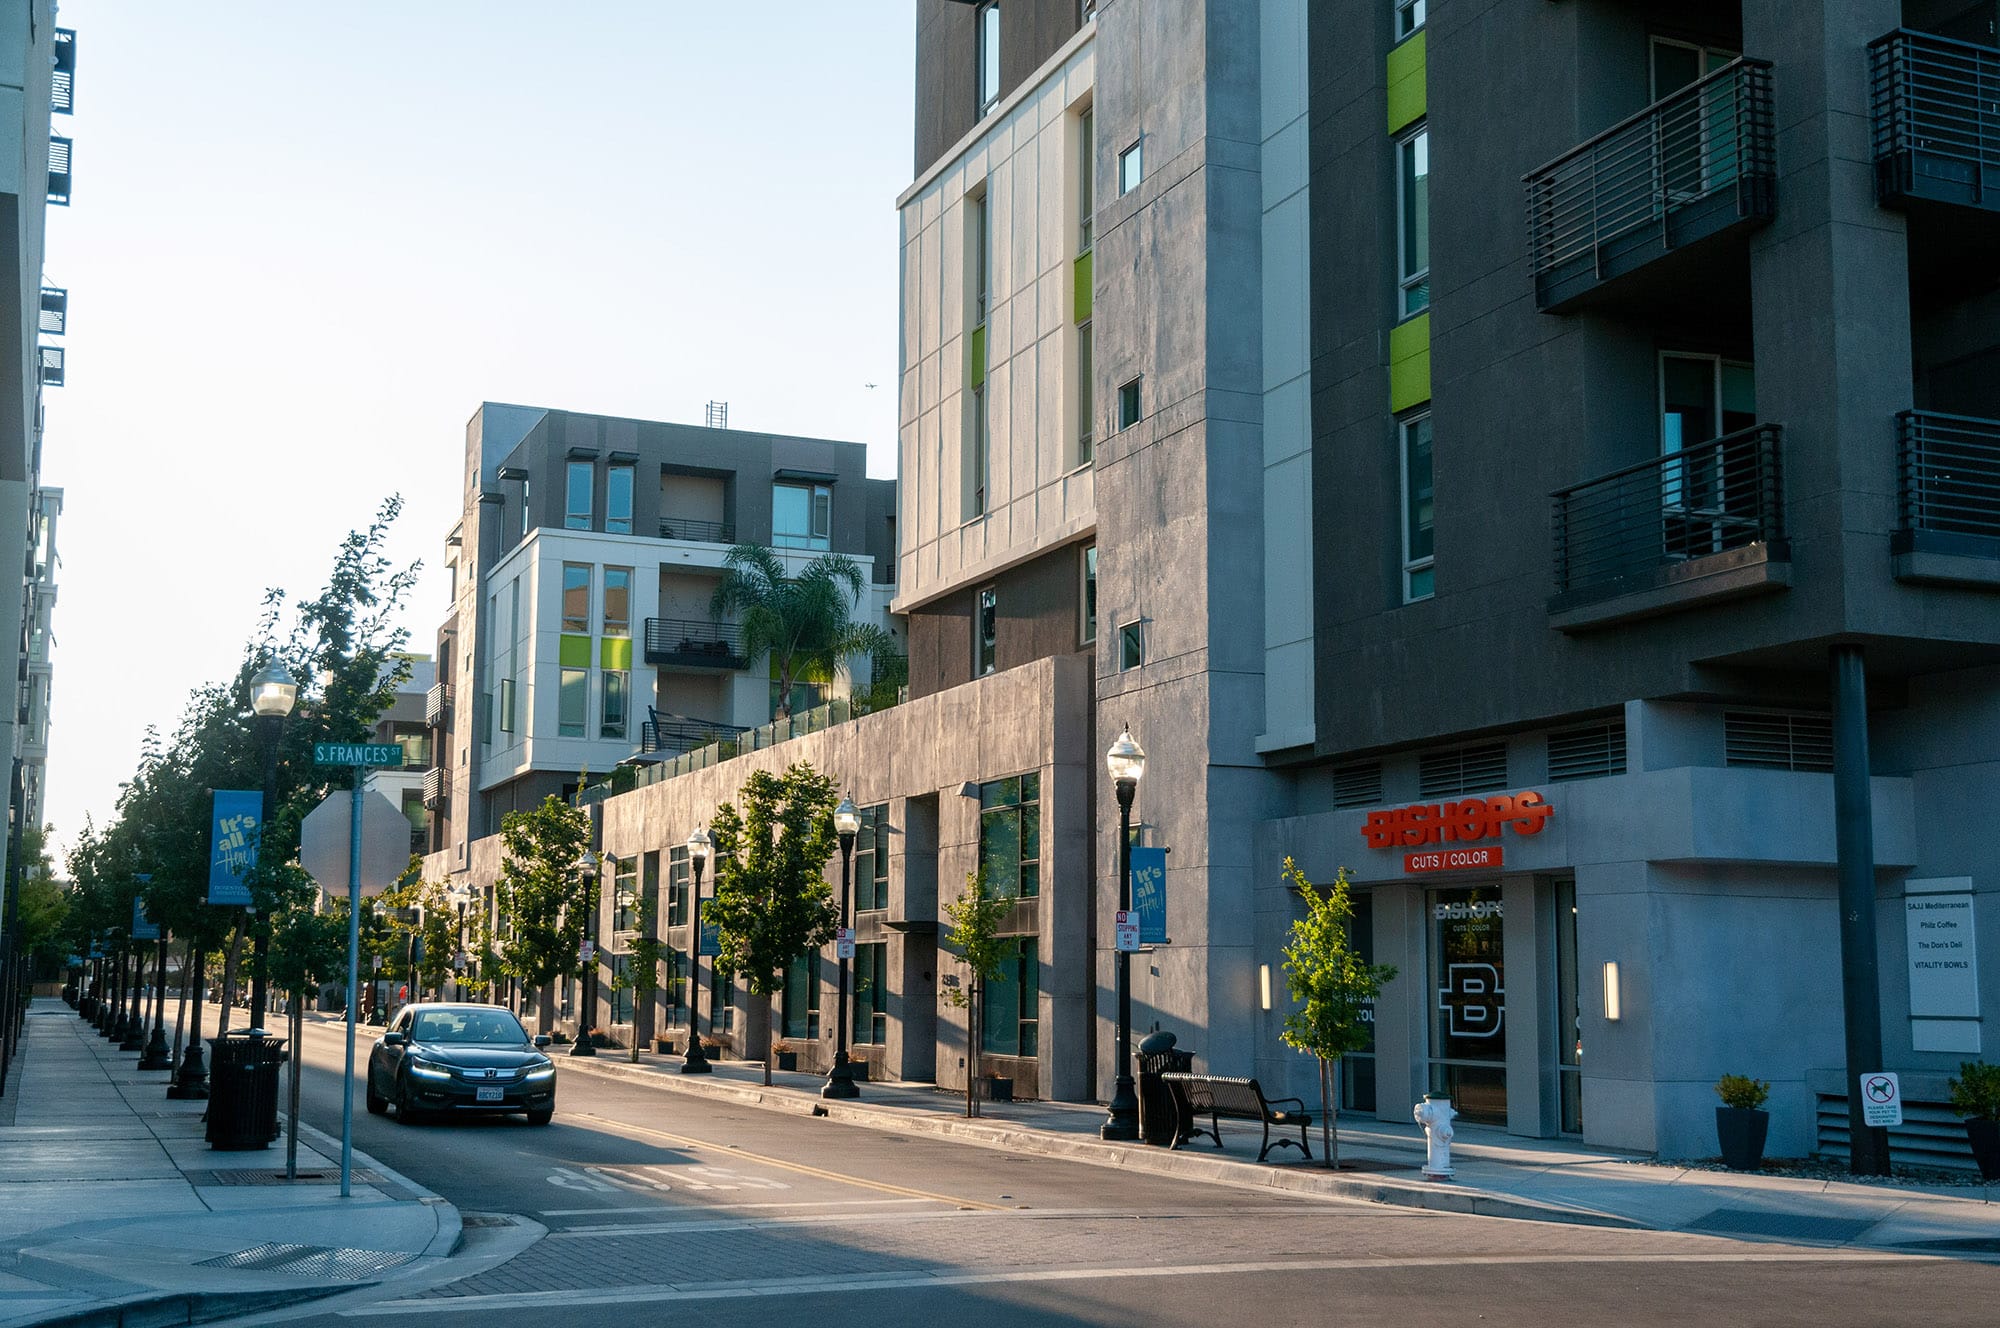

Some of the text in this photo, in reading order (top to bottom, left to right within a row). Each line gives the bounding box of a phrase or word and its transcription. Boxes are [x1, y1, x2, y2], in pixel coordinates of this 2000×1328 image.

[391, 747, 401, 756] ST
[220, 814, 256, 835] It's
[1361, 791, 1553, 848] BISHOPS
[219, 831, 245, 851] all
[1411, 855, 1439, 869] CUTS
[1450, 851, 1488, 867] COLOR
[1136, 866, 1162, 884] It's
[1137, 881, 1156, 898] all
[1925, 902, 1969, 910] Mediterranean
[1117, 912, 1127, 922] NO
[1118, 925, 1138, 933] STOPPING
[1937, 921, 1958, 929] Coffee
[1931, 941, 1949, 949] Don's
[1950, 941, 1963, 949] Deli
[1914, 961, 1969, 969] VITALITY BOWLS
